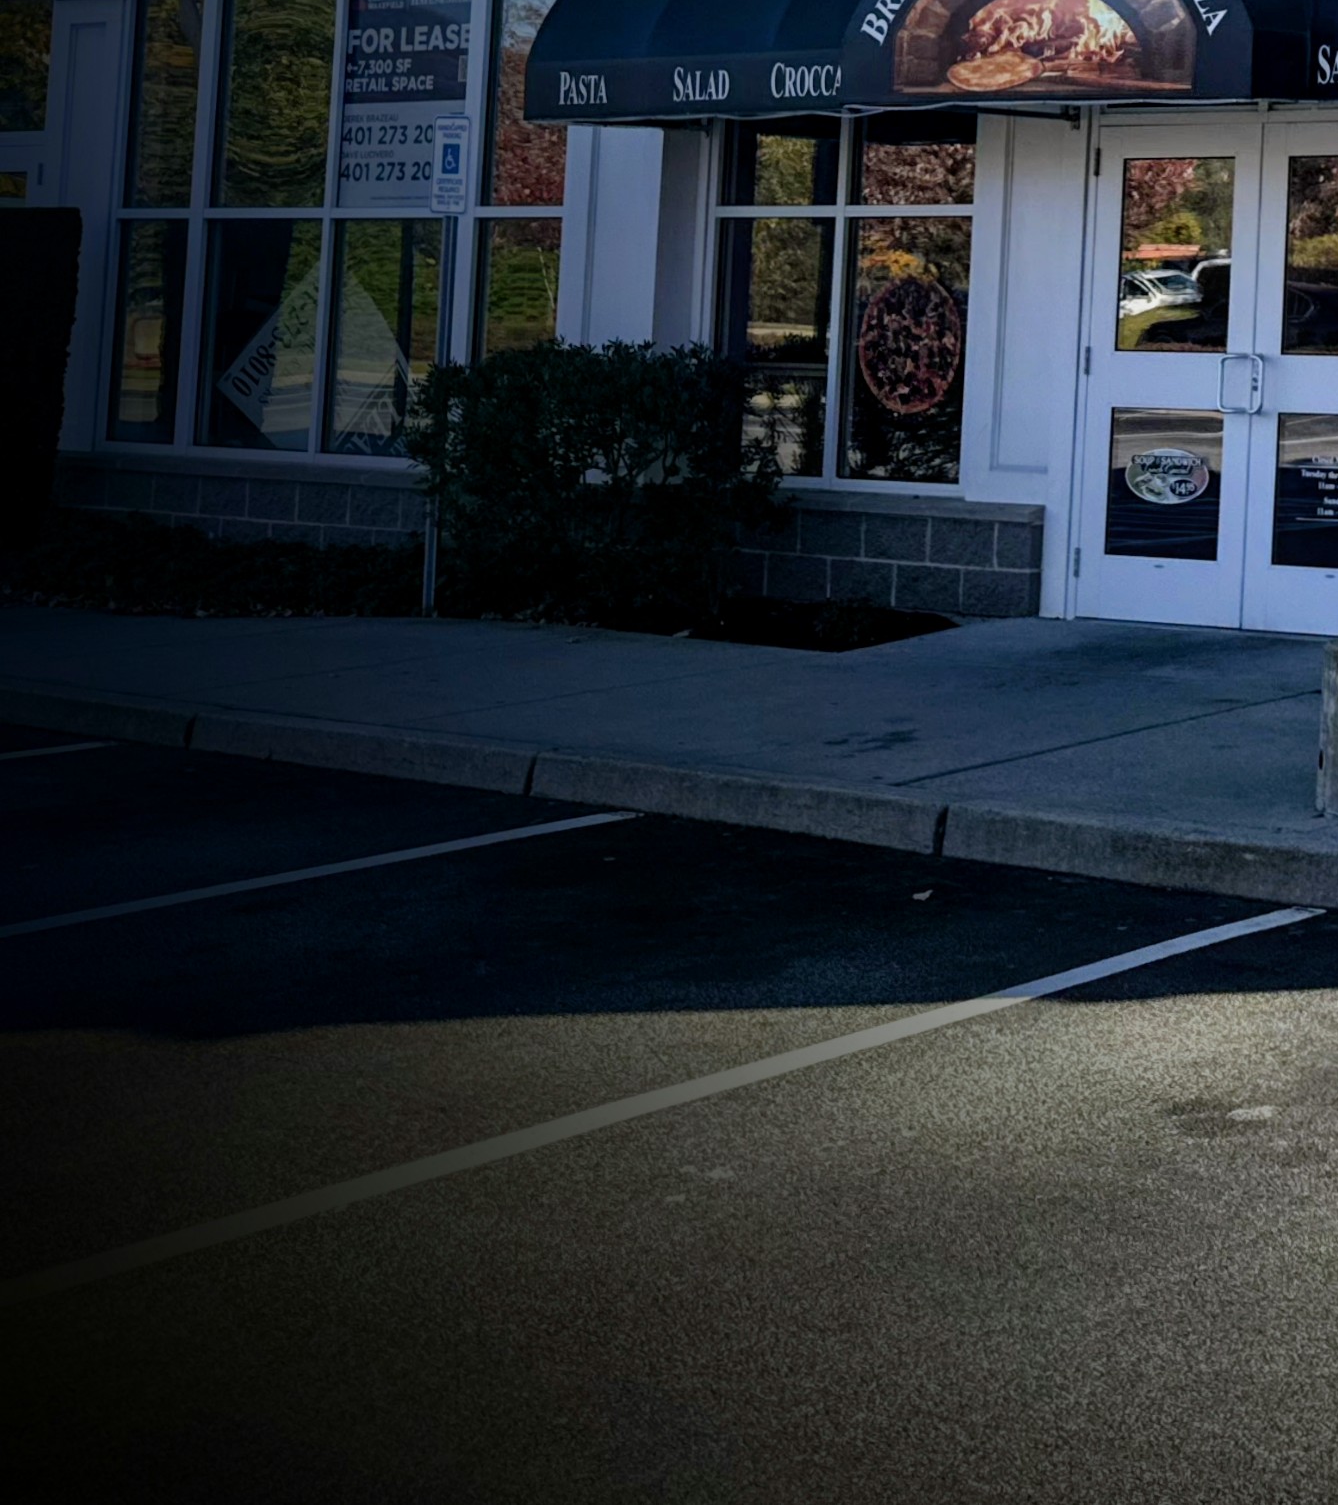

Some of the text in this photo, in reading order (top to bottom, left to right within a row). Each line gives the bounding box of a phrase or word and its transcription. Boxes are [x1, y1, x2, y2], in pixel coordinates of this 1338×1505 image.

[347, 23, 471, 55] FOR LEASE
[395, 57, 412, 73] SF
[345, 75, 435, 93] RETAIL SPACE
[558, 71, 608, 105] PASTA
[673, 66, 730, 102] SALAD
[342, 126, 372, 145] 401
[378, 125, 408, 144] 273
[340, 162, 370, 182] 401
[375, 161, 406, 182] 273
[1301, 469, 1326, 480] Tuesday
